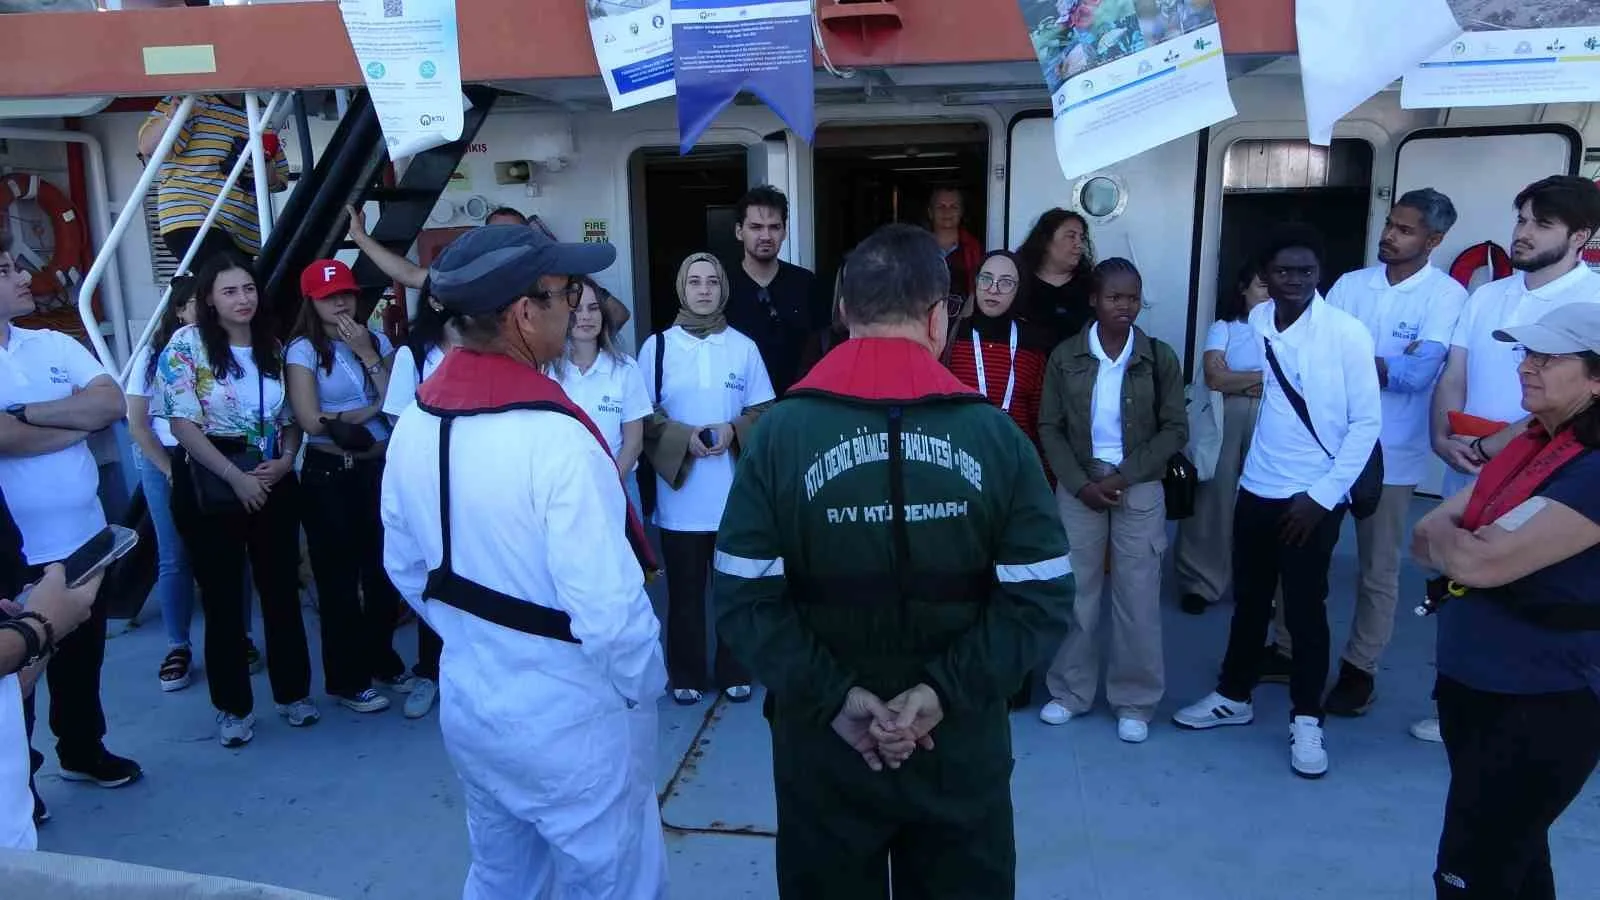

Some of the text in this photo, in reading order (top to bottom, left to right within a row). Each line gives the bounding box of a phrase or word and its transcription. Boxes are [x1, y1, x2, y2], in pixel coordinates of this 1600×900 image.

[585, 221, 606, 230] FIRE
[584, 236, 609, 244] PLAN
[323, 266, 337, 282] F
[826, 503, 858, 524] R/V
